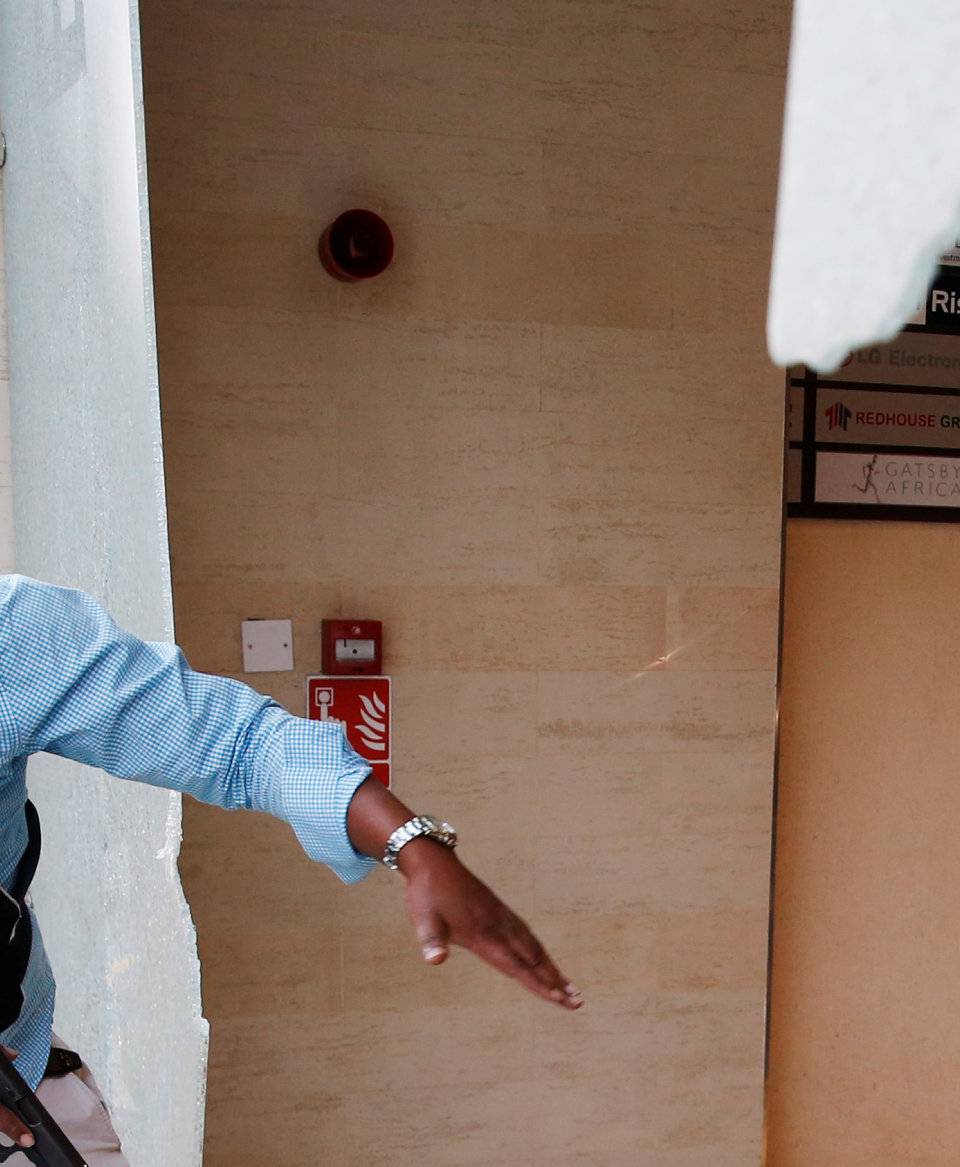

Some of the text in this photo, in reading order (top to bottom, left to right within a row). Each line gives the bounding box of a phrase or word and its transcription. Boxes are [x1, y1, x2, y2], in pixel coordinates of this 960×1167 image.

[856, 348, 881, 364] LG
[855, 411, 960, 429] REDHOUSE GR
[884, 461, 960, 480] GATSBY
[885, 481, 960, 498] AFRICA
